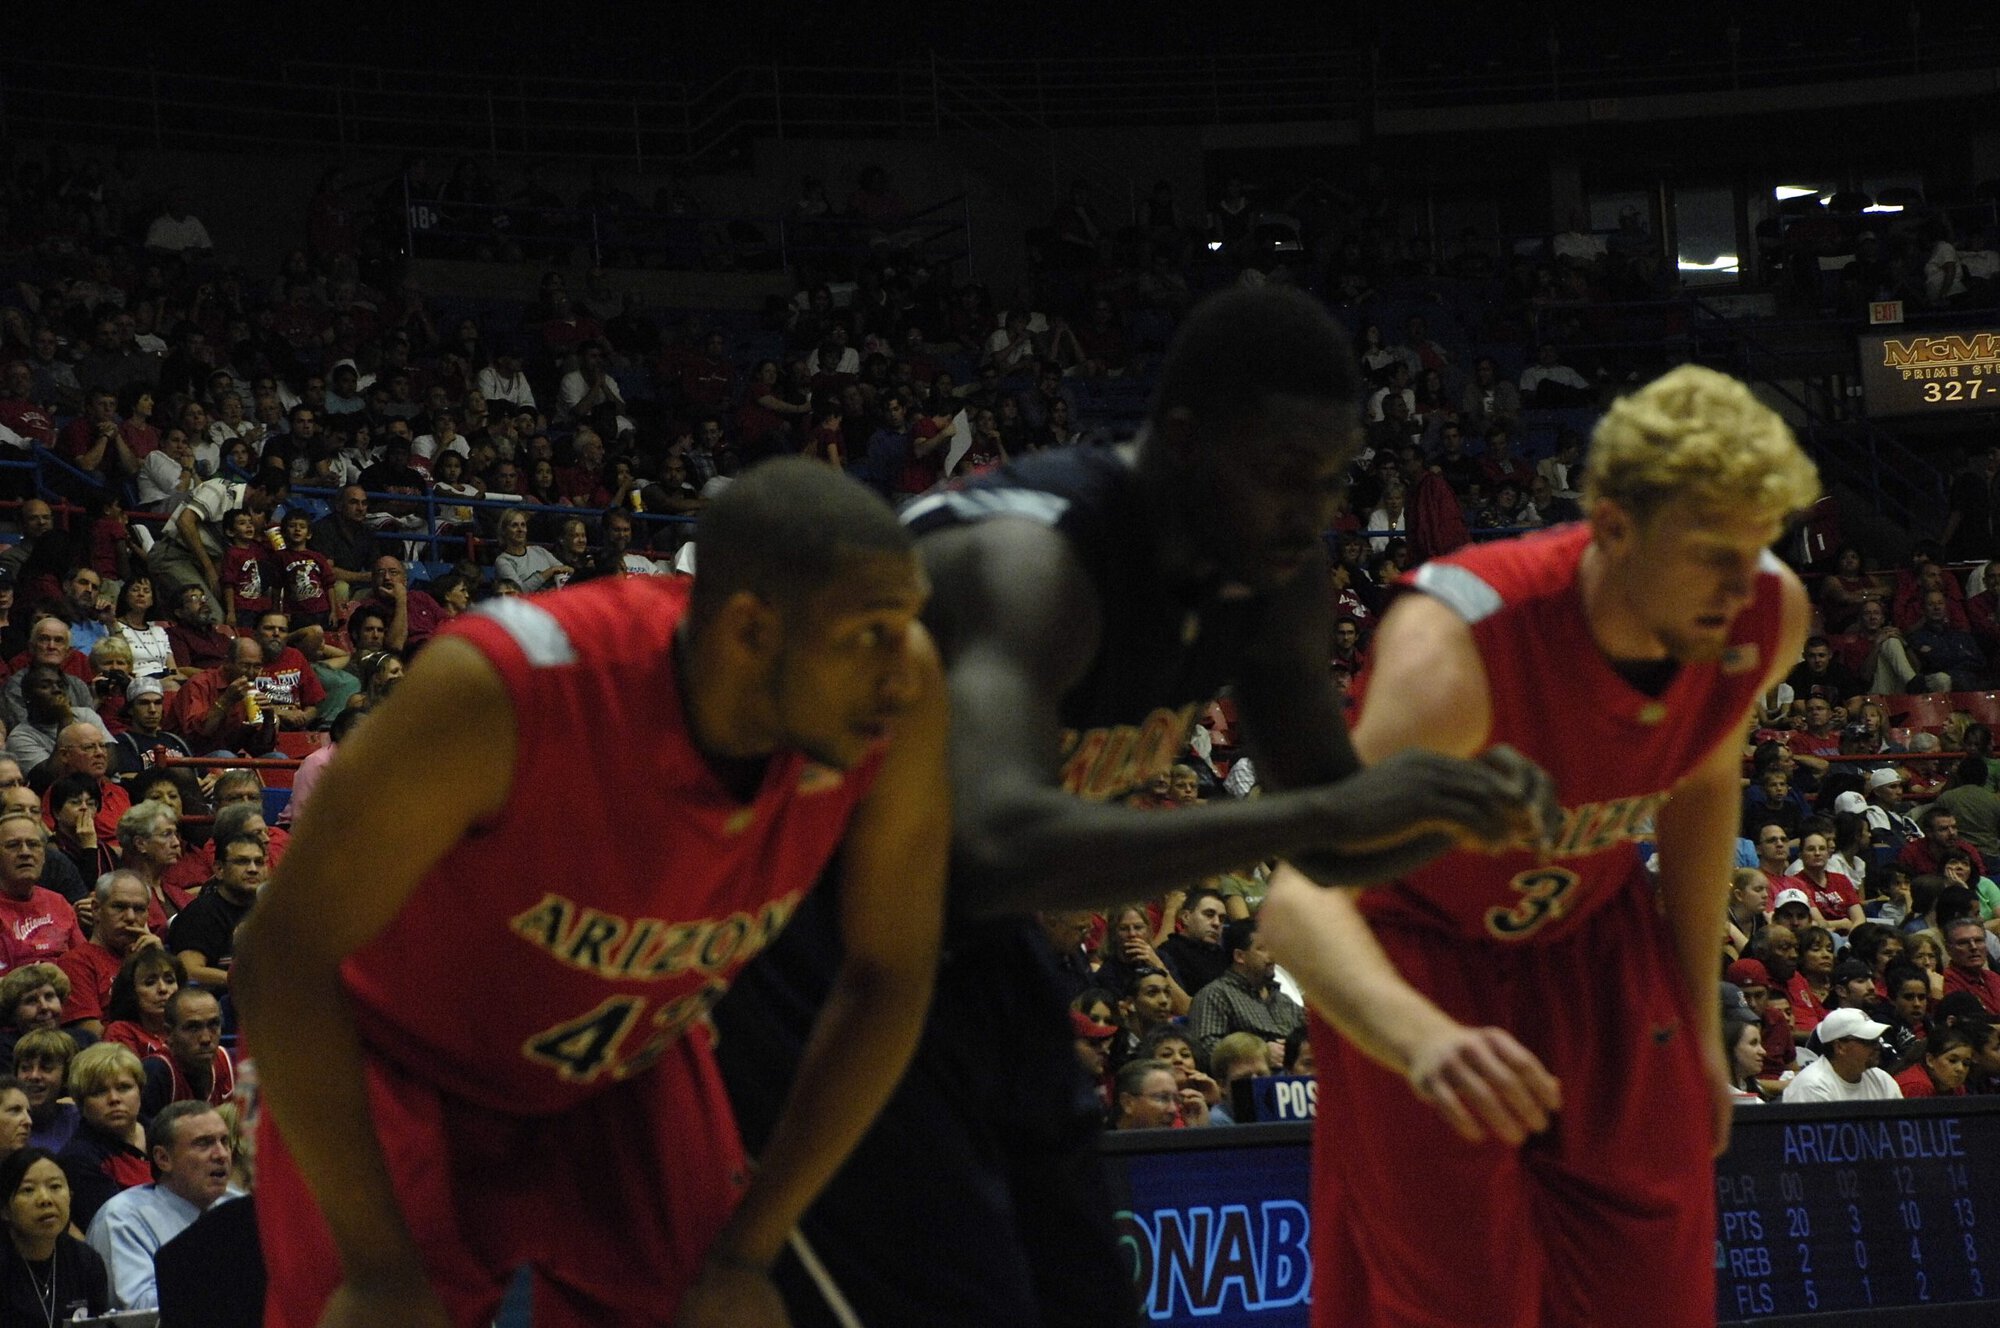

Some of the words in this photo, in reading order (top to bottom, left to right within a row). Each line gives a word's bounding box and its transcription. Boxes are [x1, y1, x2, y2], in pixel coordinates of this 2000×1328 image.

[1875, 303, 1898, 321] EXIT
[1903, 367, 1959, 380] PRIME
[1923, 379, 1997, 402] 327-
[1484, 866, 1582, 941] 3
[1784, 1121, 1897, 1164] ARIZONA
[1899, 1118, 1966, 1158] BLUE
[1723, 1210, 1763, 1240] PTS
[1786, 1207, 1810, 1237] 20
[1849, 1204, 1862, 1233] 3
[1900, 1200, 1921, 1230] 10
[1953, 1198, 1975, 1227] 13
[1730, 1247, 1772, 1278] REB
[1798, 1243, 1812, 1273] 2
[1855, 1239, 1868, 1269] 0
[1911, 1236, 1922, 1264] 4
[1965, 1233, 1977, 1262] 8
[1736, 1282, 1775, 1314] FLS
[1804, 1279, 1818, 1309] 5
[1862, 1274, 1872, 1304] 1
[1916, 1271, 1930, 1300] 2
[1970, 1267, 1983, 1297] 3
